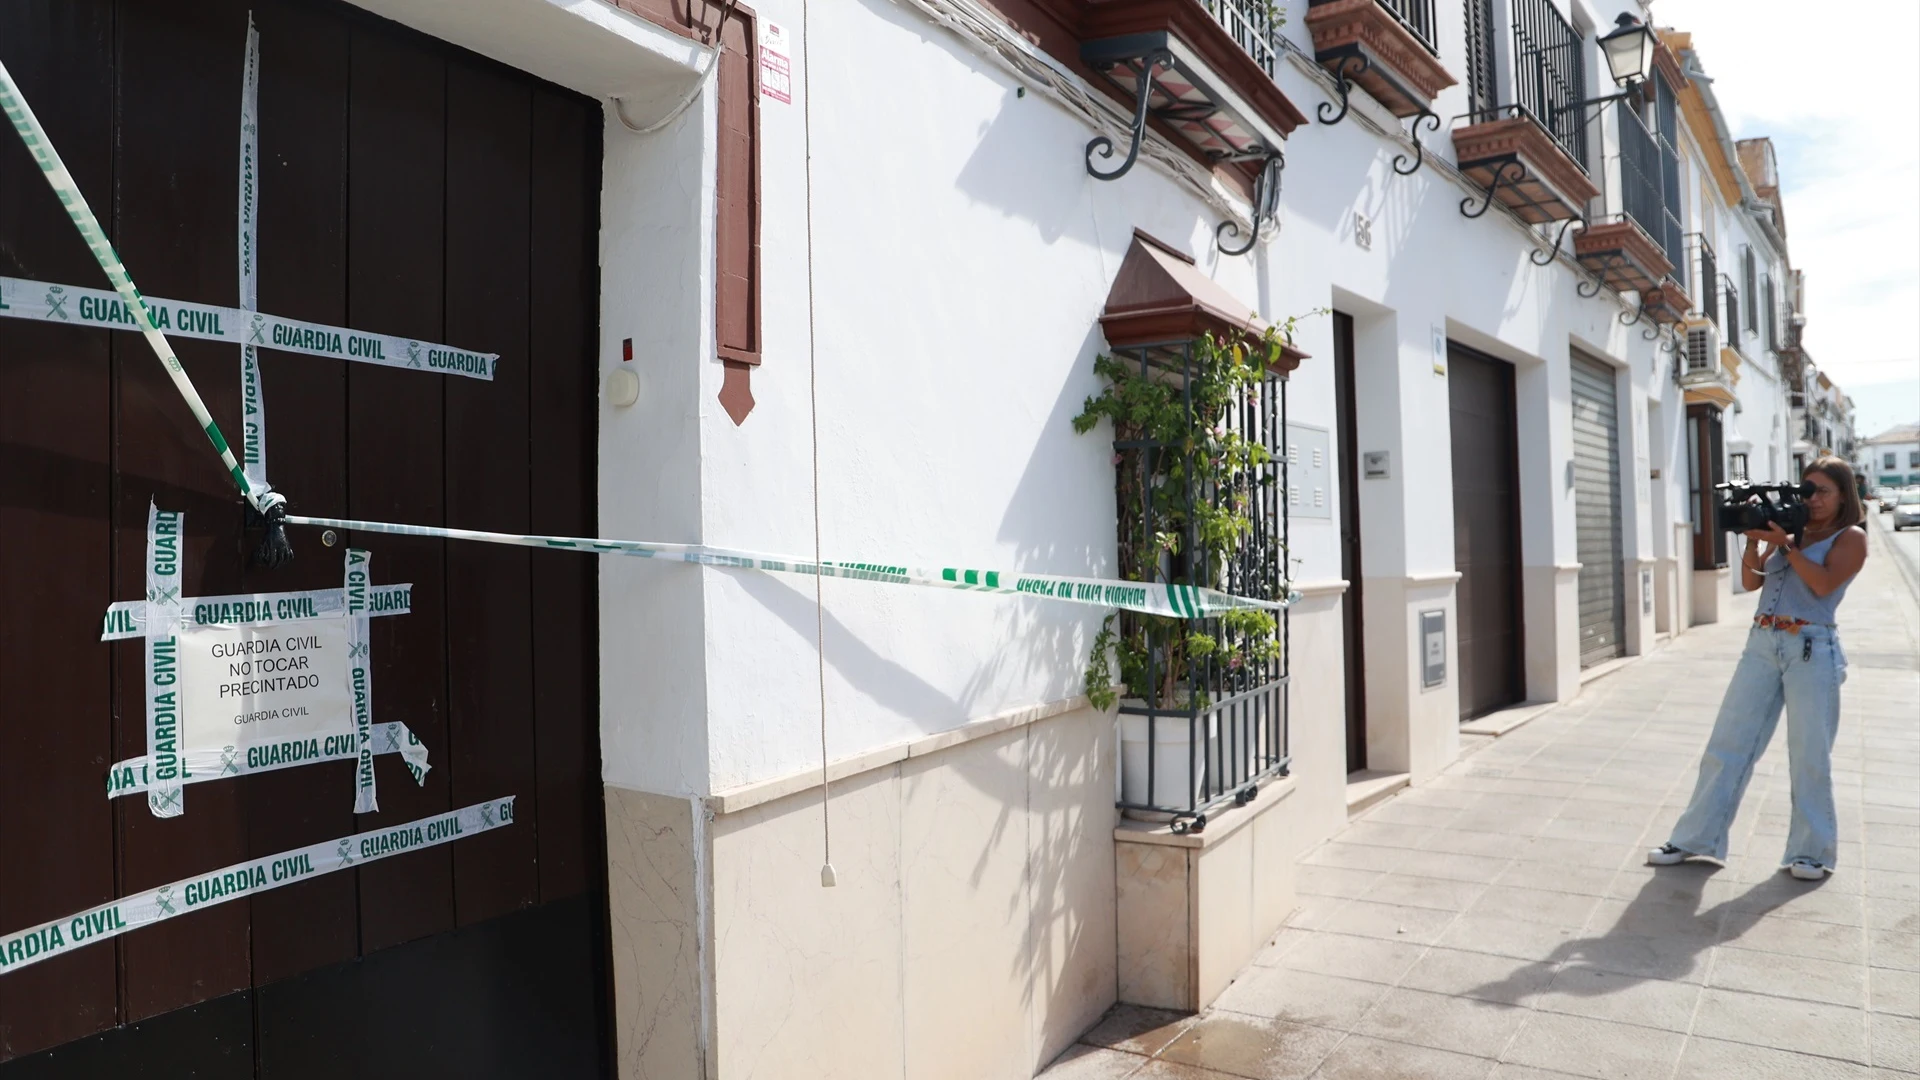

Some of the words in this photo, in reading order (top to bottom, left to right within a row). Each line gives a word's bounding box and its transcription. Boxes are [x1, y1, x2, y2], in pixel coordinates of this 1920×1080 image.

[79, 295, 171, 329] GUARIA
[177, 308, 225, 336] CIVIL
[272, 323, 343, 354] GUARDIA
[347, 336, 386, 360] CIVIL
[244, 343, 258, 416] UARDIA
[428, 349, 488, 376] GUARDIA
[154, 510, 178, 576] GUARD
[348, 570, 366, 615] CIVIL
[1077, 583, 1102, 603] CIVIL
[1105, 586, 1147, 609] GUARDIA
[194, 600, 273, 626] GUARDIA
[277, 597, 319, 621] CIVIL
[153, 635, 177, 686] CIVIL
[211, 638, 282, 658] GUARDIA
[285, 635, 323, 650] CIVIL
[229, 661, 251, 677] NO
[254, 656, 310, 674] TOCAR
[219, 674, 320, 699] PRECINTADO
[234, 710, 279, 725] GUARDIA
[281, 706, 310, 718] CIVIL
[352, 667, 370, 745] GUARDIA
[154, 691, 178, 780] GUARDIA
[247, 738, 320, 769] GUARDIA
[324, 733, 359, 761] CIVI
[360, 826, 424, 858] GUARDIA
[427, 816, 463, 842] CIVIL
[184, 864, 267, 906] GUARDIA
[272, 853, 315, 882] CIVIL
[71, 906, 127, 942] CIVIL
